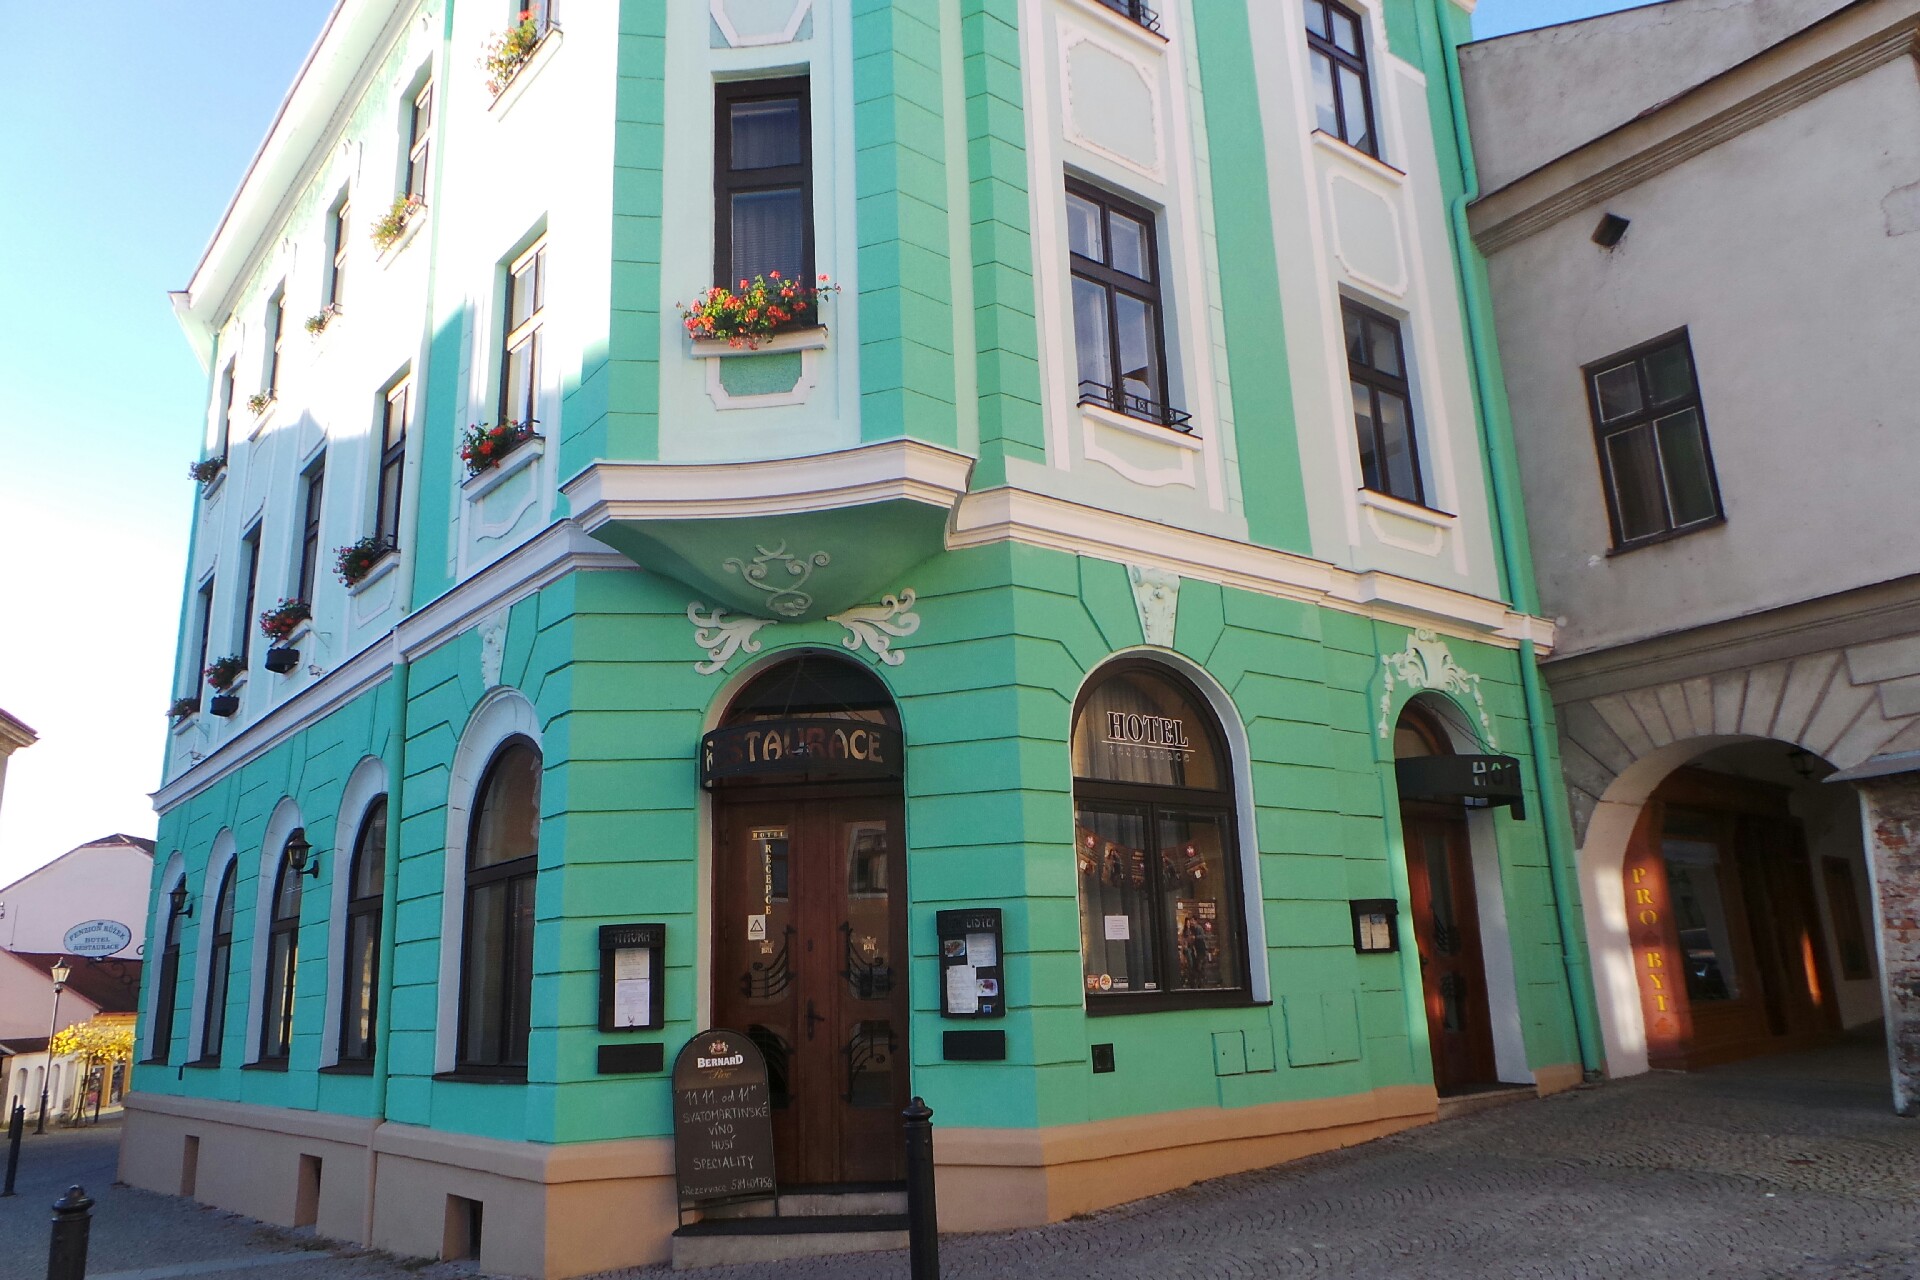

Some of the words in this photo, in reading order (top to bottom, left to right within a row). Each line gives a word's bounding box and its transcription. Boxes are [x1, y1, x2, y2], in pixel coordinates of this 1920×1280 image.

[1106, 711, 1189, 748] HOTEL
[706, 727, 884, 772] RSTAURACE
[69, 925, 102, 941] PENZION
[1632, 867, 1658, 926] PRO
[1647, 952, 1669, 1012] BYT
[697, 1054, 744, 1069] BERNARD
[721, 1089, 735, 1103] od
[683, 1101, 769, 1123] SVATOMARTINSKÉ
[708, 1121, 734, 1136] VÍNO
[711, 1134, 737, 1150] HUSÍ
[693, 1155, 754, 1170] SPECIALITY
